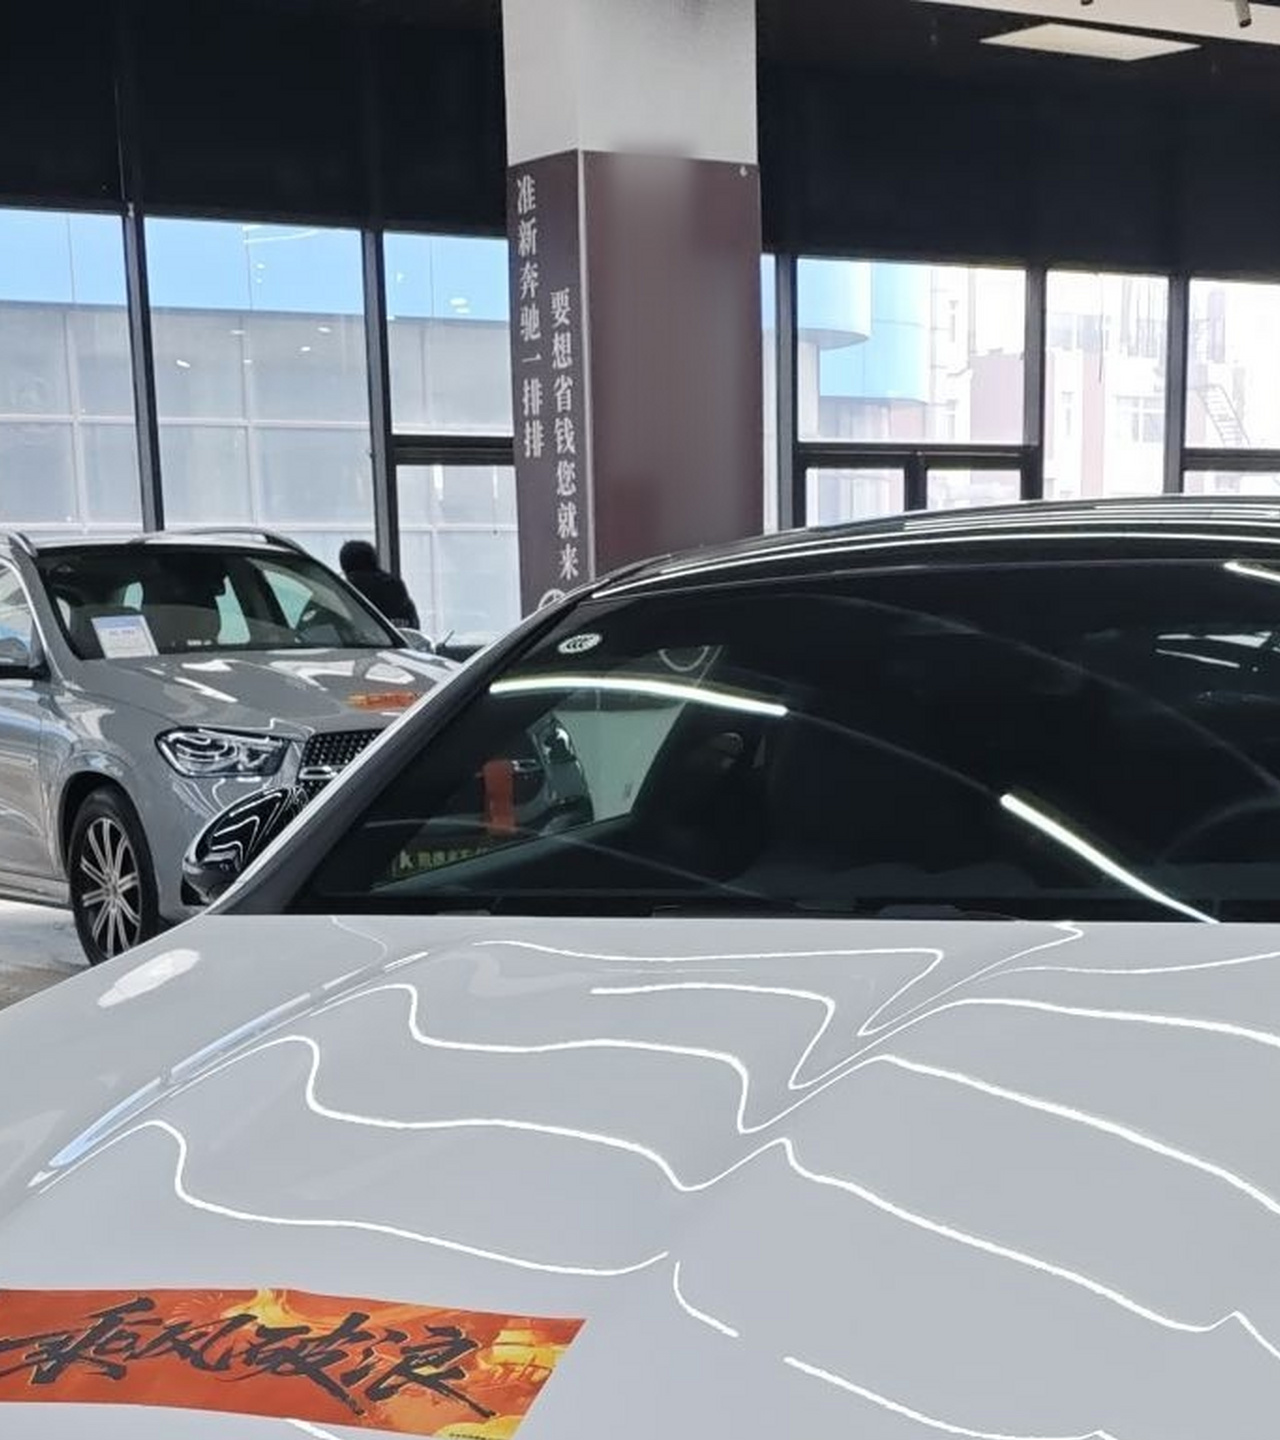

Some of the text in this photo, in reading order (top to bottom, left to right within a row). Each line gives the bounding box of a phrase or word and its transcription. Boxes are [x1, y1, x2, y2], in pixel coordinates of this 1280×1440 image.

[517, 174, 545, 458] 准新奔驰一排排
[550, 287, 579, 581] 要想省钱您就来
